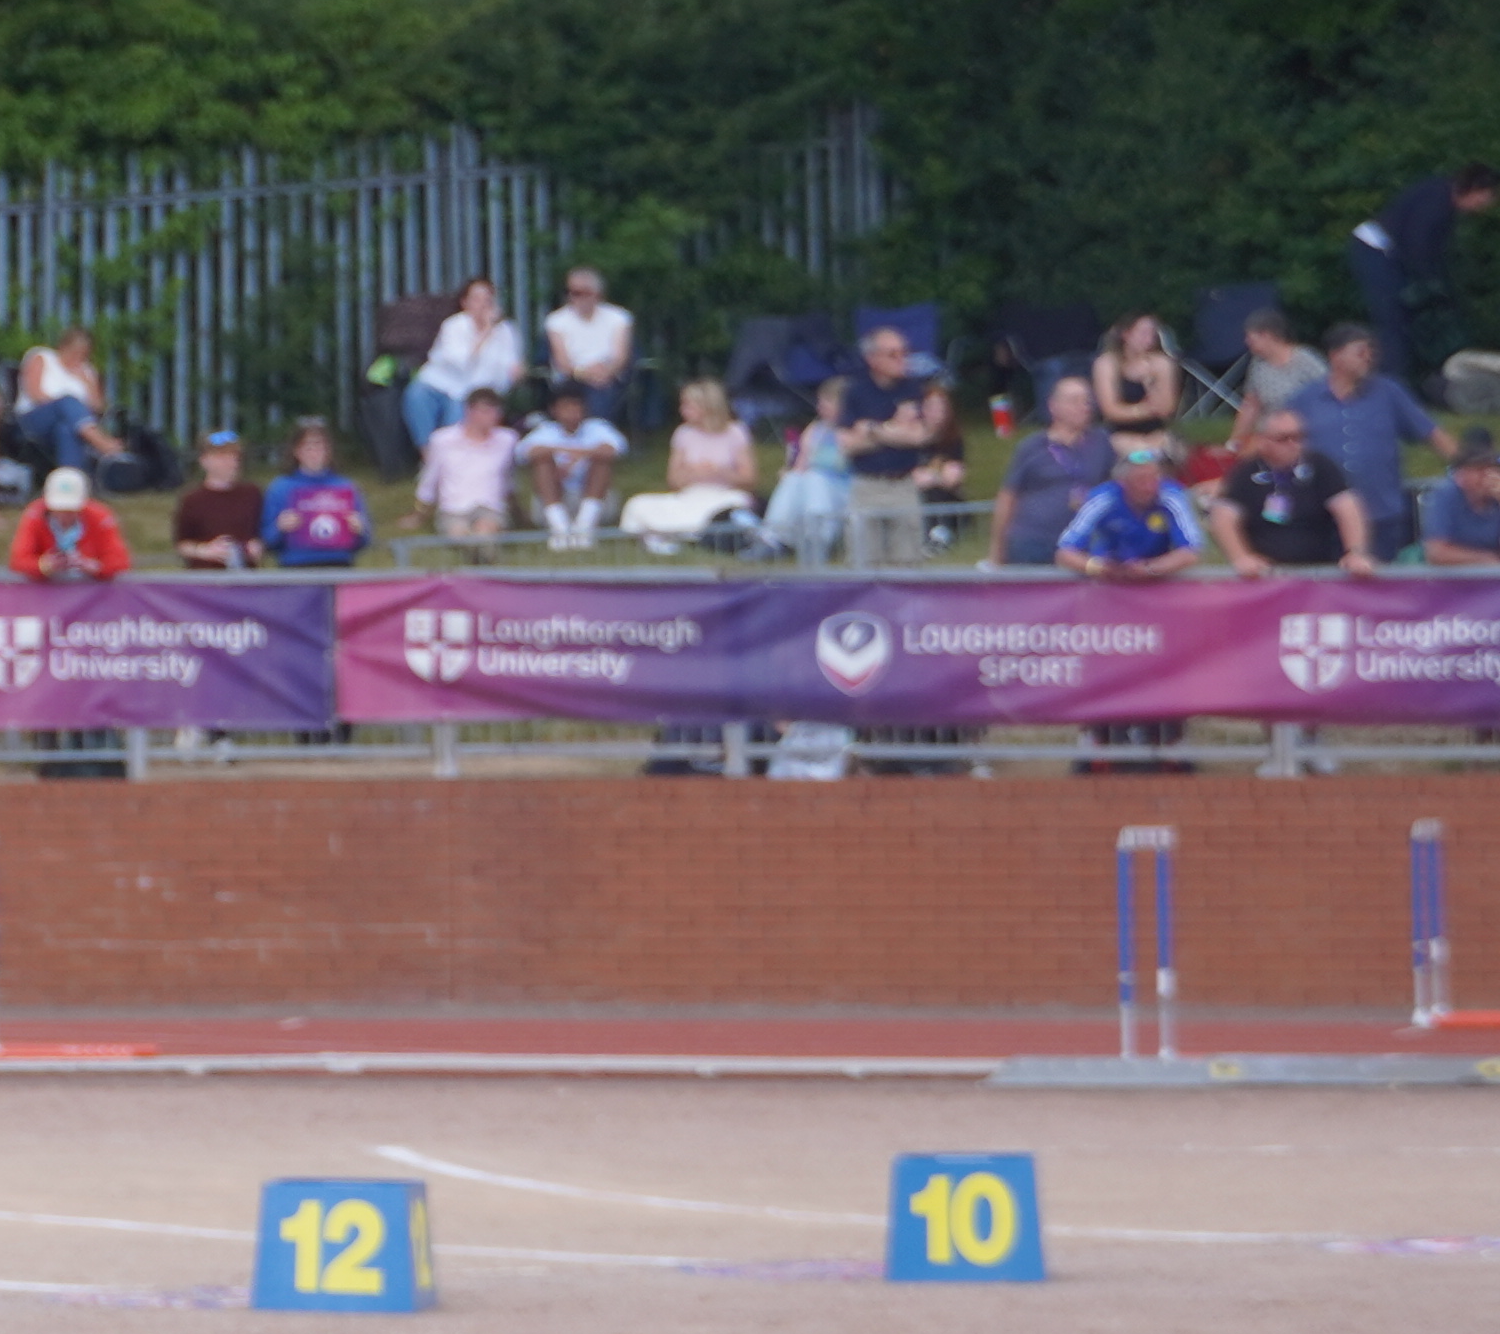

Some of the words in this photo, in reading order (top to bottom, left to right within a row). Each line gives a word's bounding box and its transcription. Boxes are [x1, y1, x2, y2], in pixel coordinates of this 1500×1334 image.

[49, 616, 268, 655] Loughborough
[478, 614, 701, 653] Loughborough
[903, 623, 1163, 656] LOUGHBOROUGH
[49, 650, 202, 688] University
[477, 647, 632, 685] University
[977, 655, 1084, 687] SPORT
[909, 1170, 1019, 1268] 10
[279, 1198, 386, 1297] 12
